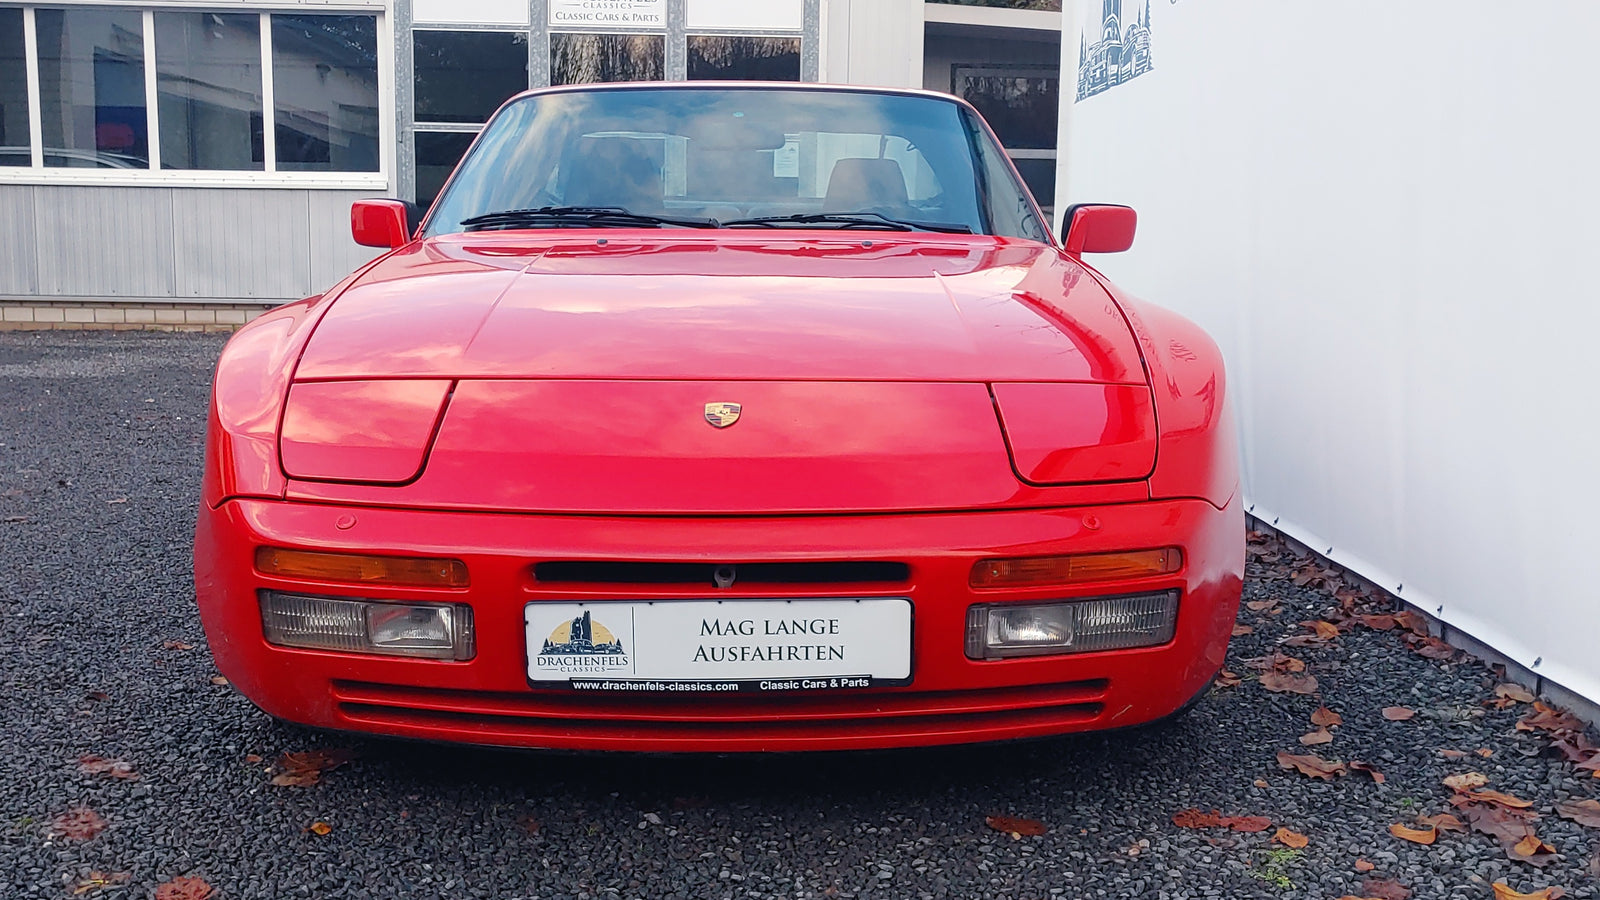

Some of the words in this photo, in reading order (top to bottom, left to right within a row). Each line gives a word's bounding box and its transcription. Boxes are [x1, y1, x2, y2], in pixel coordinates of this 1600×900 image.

[555, 11, 593, 20] CLASSIC
[595, 12, 619, 21] CARS
[621, 13, 630, 21] &
[632, 13, 659, 22] PARTS
[699, 618, 754, 636] MAG
[764, 619, 839, 635] LANGE
[692, 644, 844, 662] AUSFAHRTEN
[537, 656, 628, 666] DRACHENFELS
[572, 680, 739, 692] www.drachenfels-classics.com
[759, 680, 800, 691] Classic
[801, 679, 828, 689] Cars
[829, 678, 839, 688] &
[840, 678, 869, 688] Parts
